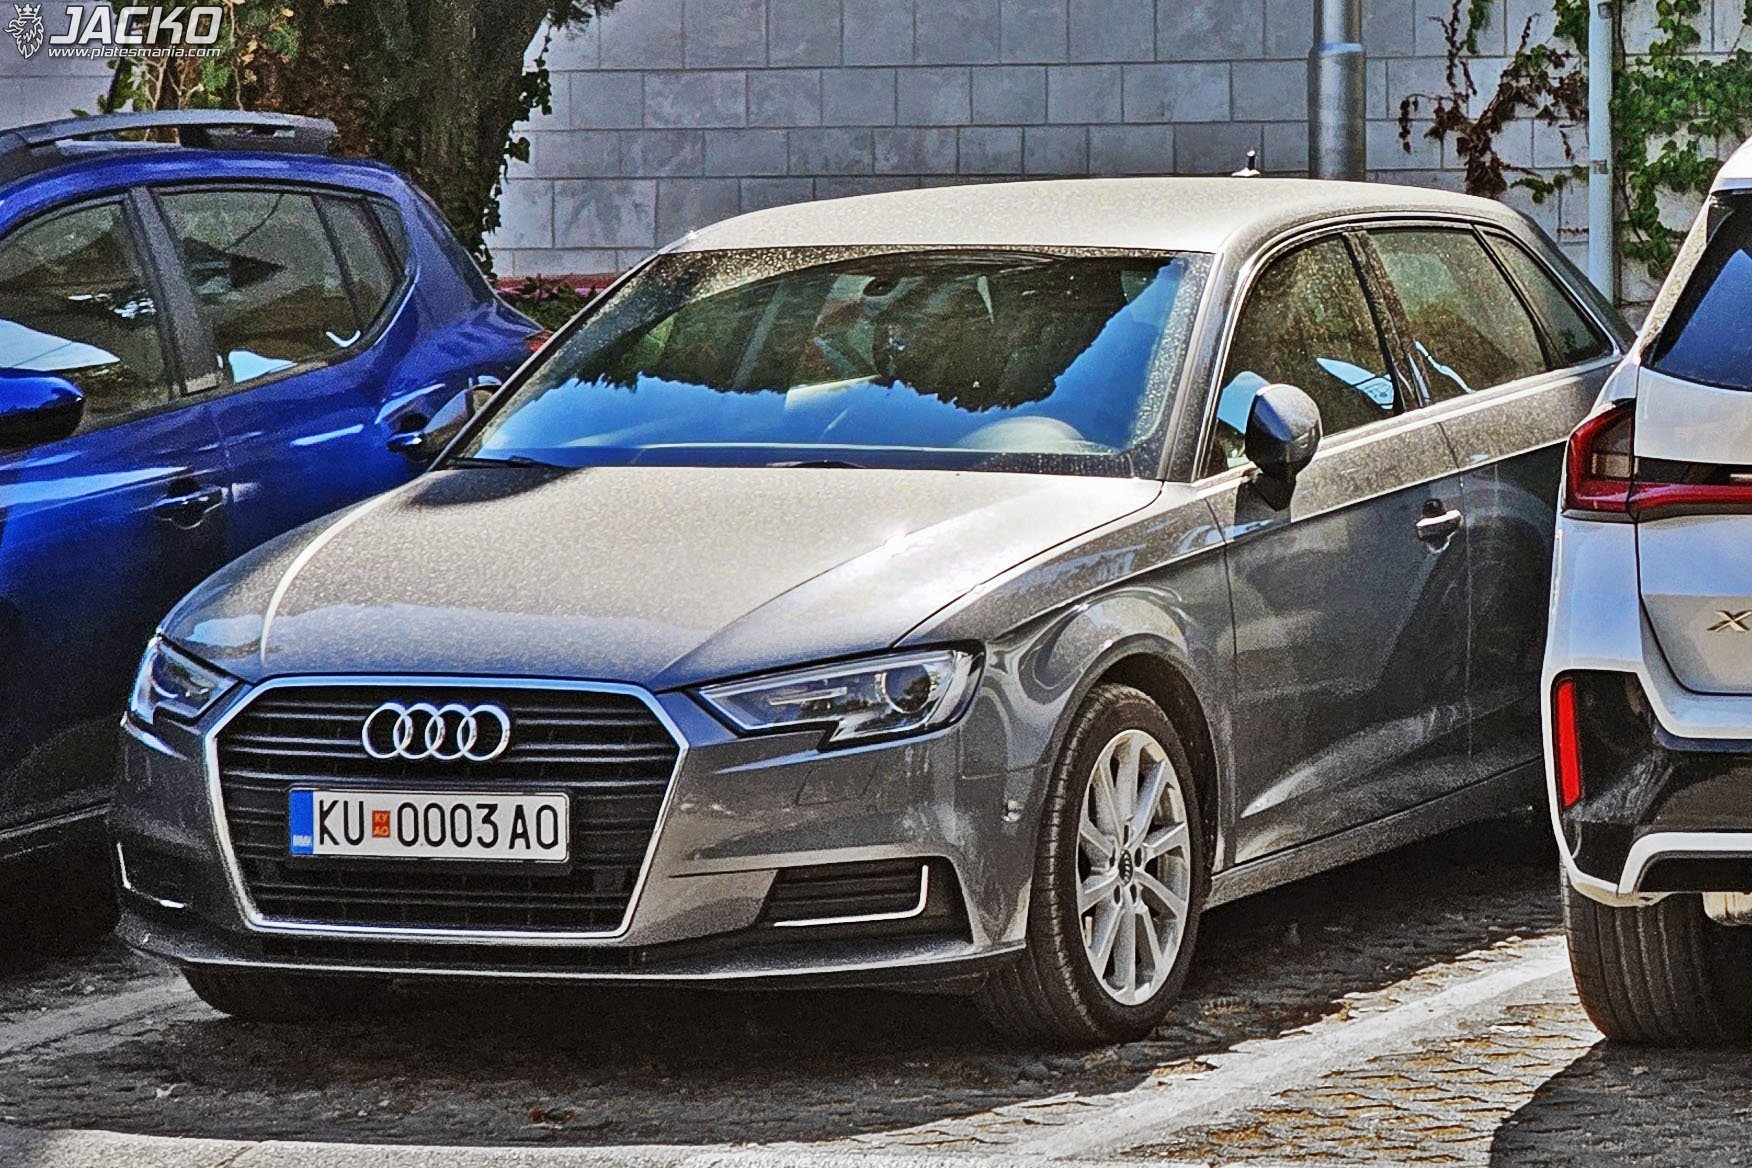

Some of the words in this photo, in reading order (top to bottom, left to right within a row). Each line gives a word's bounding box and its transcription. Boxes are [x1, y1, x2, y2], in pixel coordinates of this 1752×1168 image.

[319, 800, 365, 846] KU
[397, 802, 499, 848] 0003
[508, 804, 559, 850] AO
